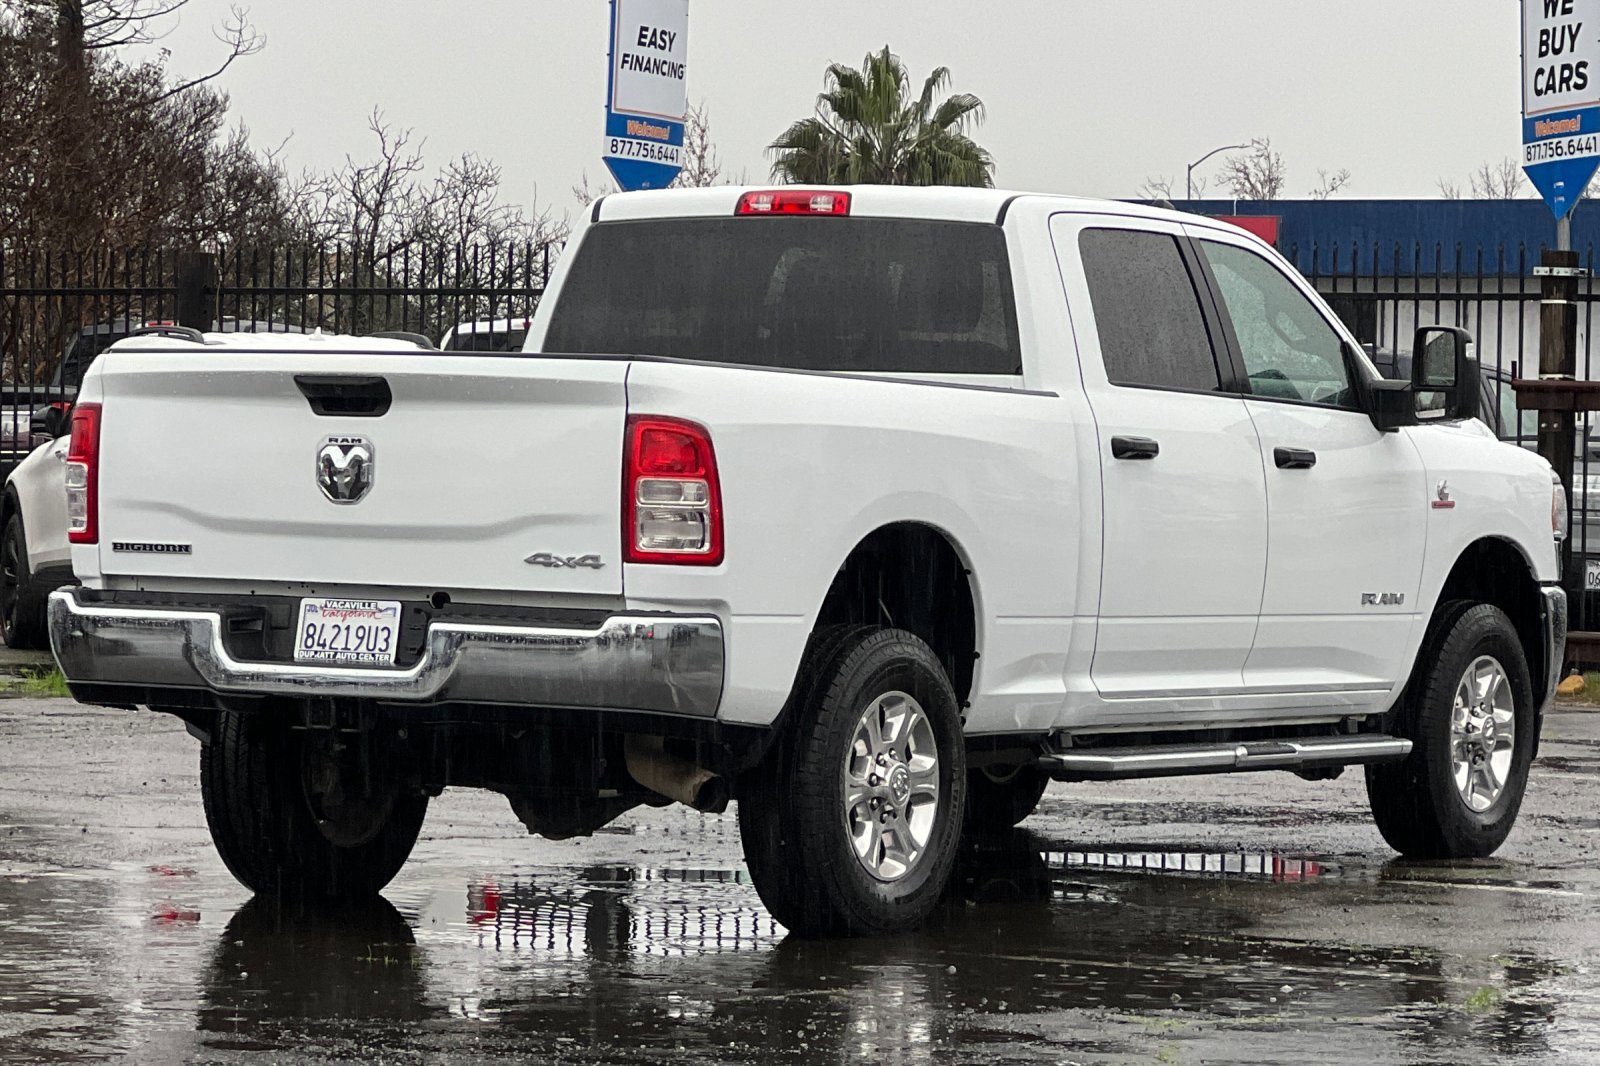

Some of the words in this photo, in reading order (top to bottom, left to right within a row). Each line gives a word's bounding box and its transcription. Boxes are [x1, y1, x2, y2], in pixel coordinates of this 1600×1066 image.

[637, 25, 676, 52] EASY
[1538, 22, 1582, 58] BUY
[620, 53, 684, 80] FINANCING
[1533, 61, 1589, 97] CARS
[627, 119, 670, 140] Welcome!
[1535, 114, 1581, 138] Welcome!
[610, 138, 679, 164] 877.756.6441
[1526, 136, 1597, 162] 877.756.6441
[112, 542, 192, 554] BIGHORN
[524, 552, 606, 570] 4x4
[326, 600, 378, 610] VACAVILLE
[1361, 592, 1404, 605] RAM
[303, 622, 392, 652] 84219U3
[336, 653, 357, 661] AUTO
